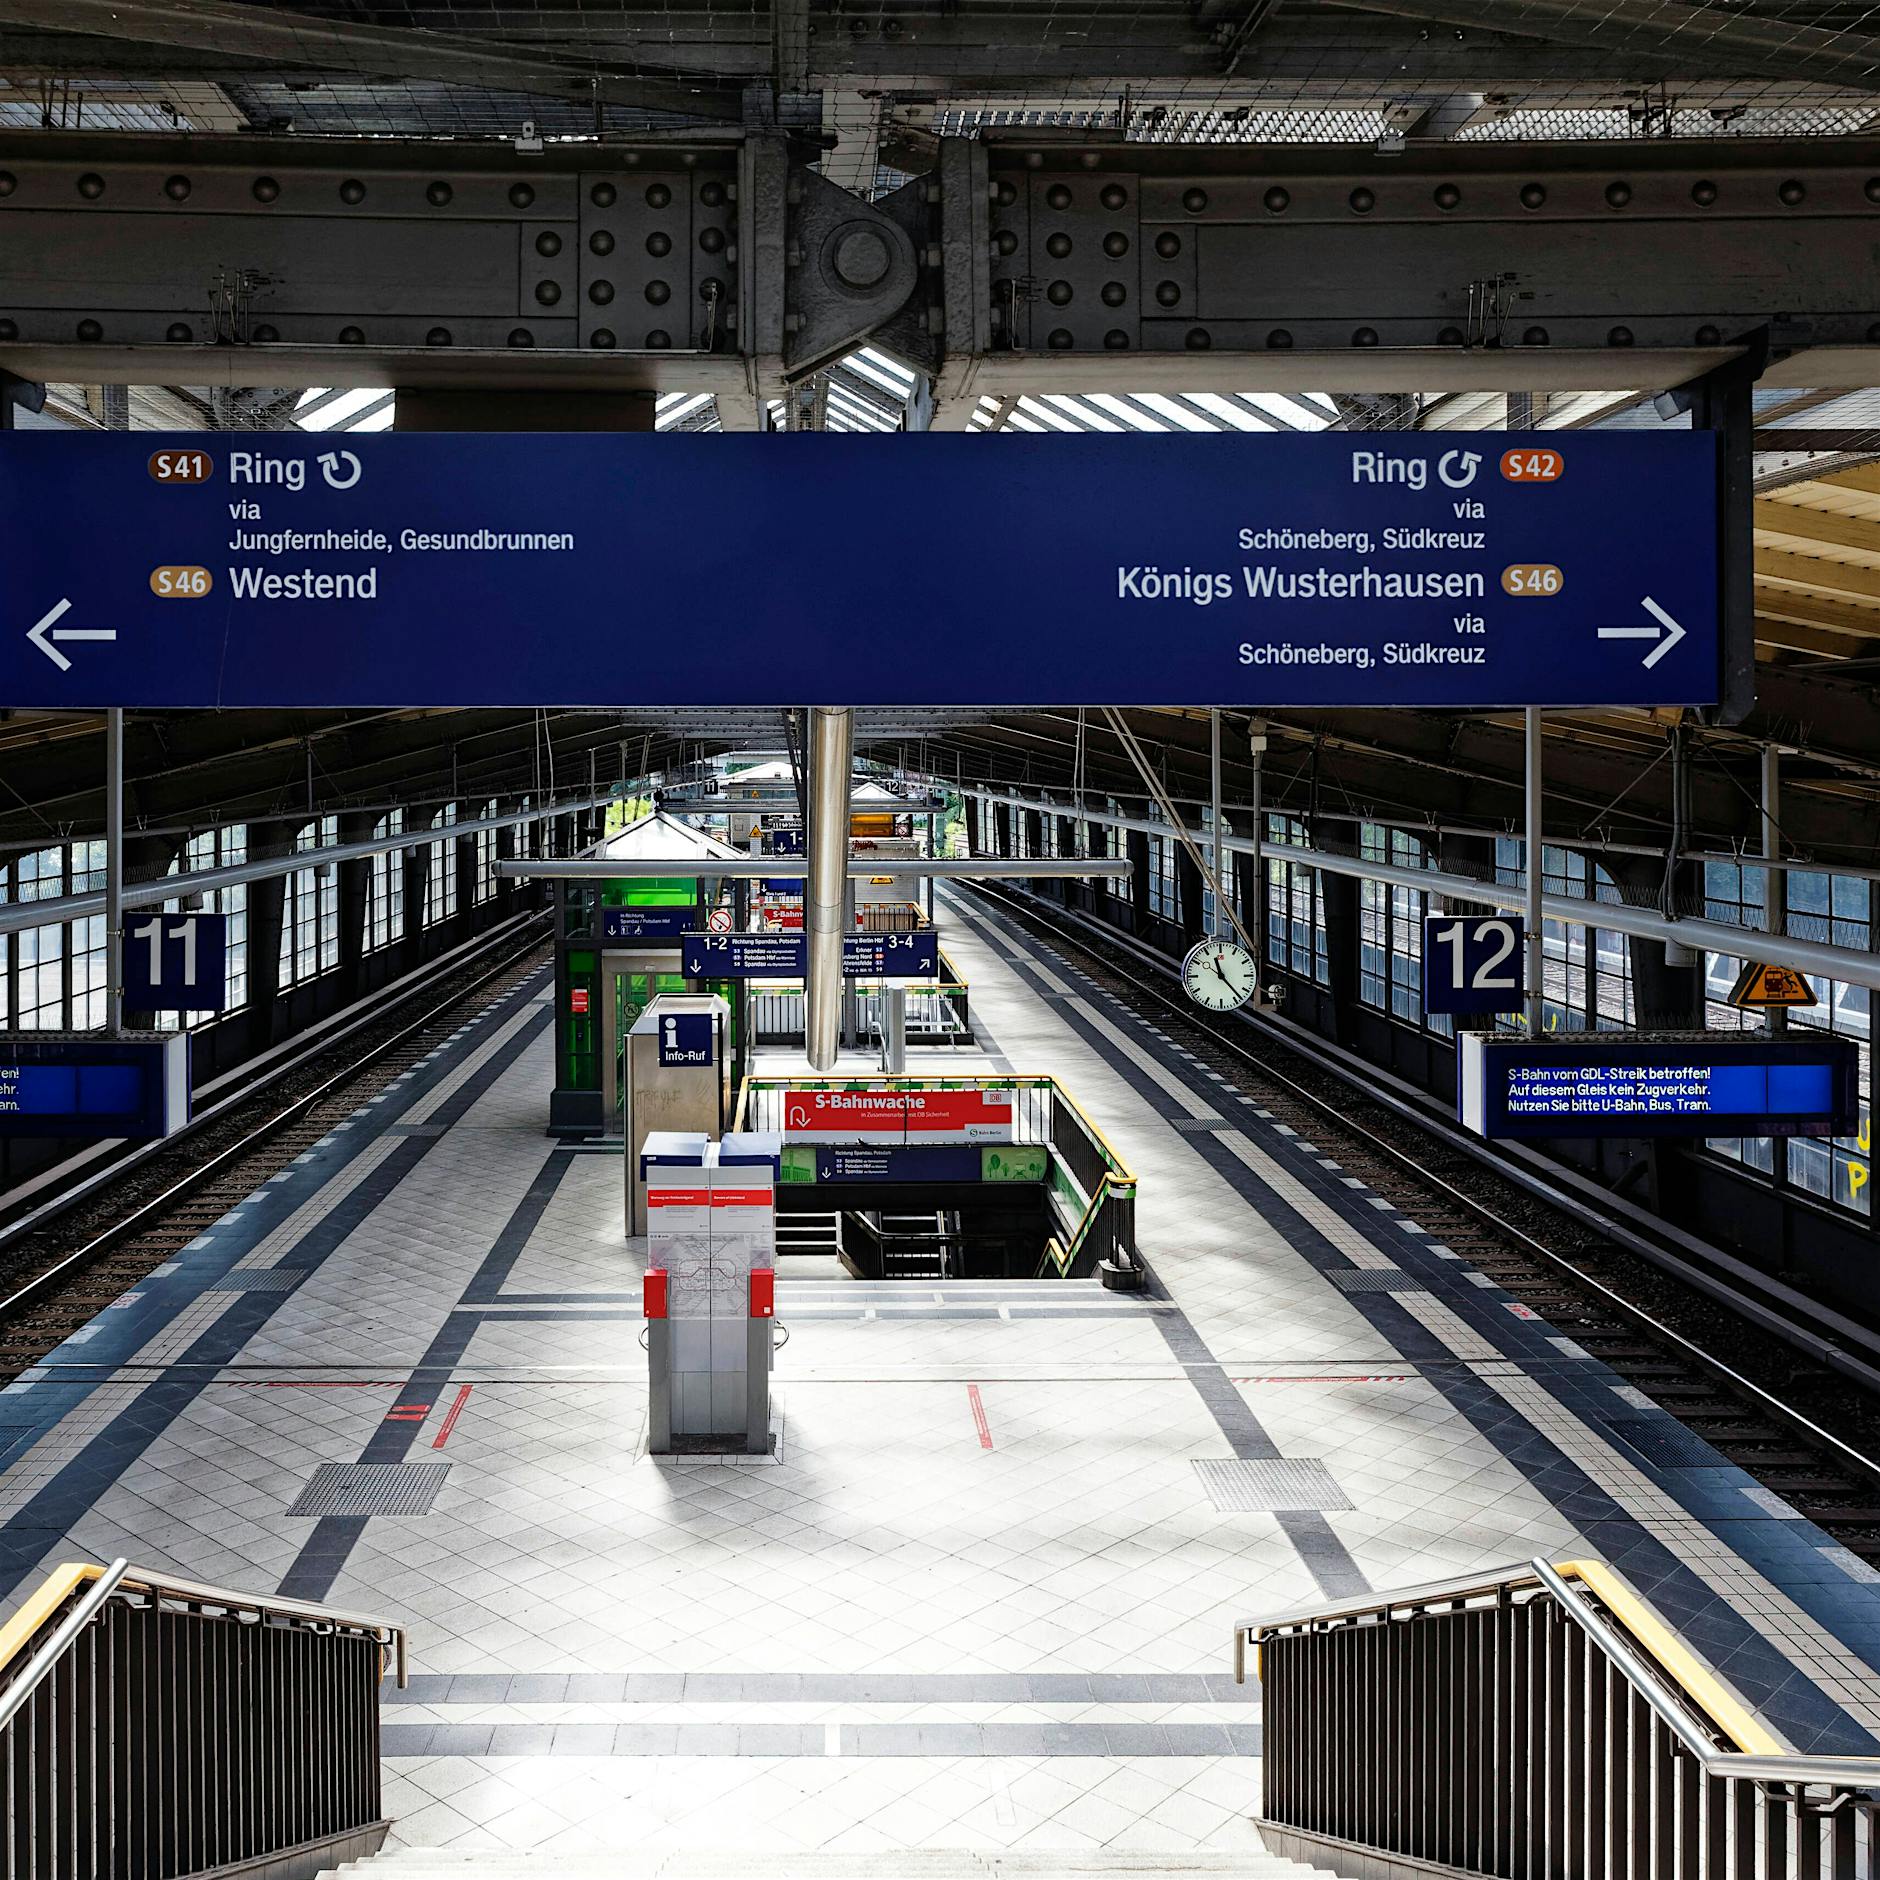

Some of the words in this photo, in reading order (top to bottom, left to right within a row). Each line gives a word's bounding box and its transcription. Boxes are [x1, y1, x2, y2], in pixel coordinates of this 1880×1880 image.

[229, 452, 305, 491] Ring
[1352, 451, 1427, 490] Ring
[1509, 454, 1556, 478] S42
[229, 499, 261, 520] via
[1453, 498, 1486, 519] via
[229, 529, 393, 554] Jungfernheide,
[400, 528, 574, 550] Gesundbrunnen
[1239, 528, 1376, 554] Schöneberg,
[1383, 527, 1486, 550] Südkreuz
[158, 571, 206, 593] S46
[229, 567, 377, 599] Westend
[1117, 566, 1233, 606] Königs
[1242, 566, 1484, 598] Wusterhausen
[1510, 569, 1557, 592] S46
[1453, 612, 1486, 634] via
[1239, 642, 1376, 668] Schöneberg,
[1383, 641, 1486, 664] Südkreuz
[705, 781, 715, 792] 11
[886, 781, 899, 791] 12
[134, 918, 197, 985] 11
[704, 937, 728, 950] 1-2
[888, 935, 914, 949] 3-4
[1437, 920, 1516, 989] 12
[665, 1051, 706, 1061] Info-Ruf
[1508, 1068, 1550, 1080] S-Bahn
[1553, 1070, 1578, 1080] vom
[1580, 1067, 1647, 1080] GDL-Streik
[1649, 1067, 1711, 1079] betroffen!
[1508, 1084, 1530, 1096] Auf
[1532, 1084, 1575, 1096] diesem
[1577, 1084, 1607, 1096] Gleis
[1609, 1084, 1635, 1095] kein
[1636, 1083, 1711, 1098] Zugverkehr.
[815, 1094, 926, 1109] S-Bahnwache
[1508, 1100, 1550, 1111] Nutzen
[1551, 1099, 1570, 1111] Sie
[1571, 1099, 1600, 1111] bitte
[1601, 1099, 1648, 1112] U-Bahn,
[1649, 1099, 1675, 1112] Bus,
[1677, 1099, 1712, 1111] Tram.
